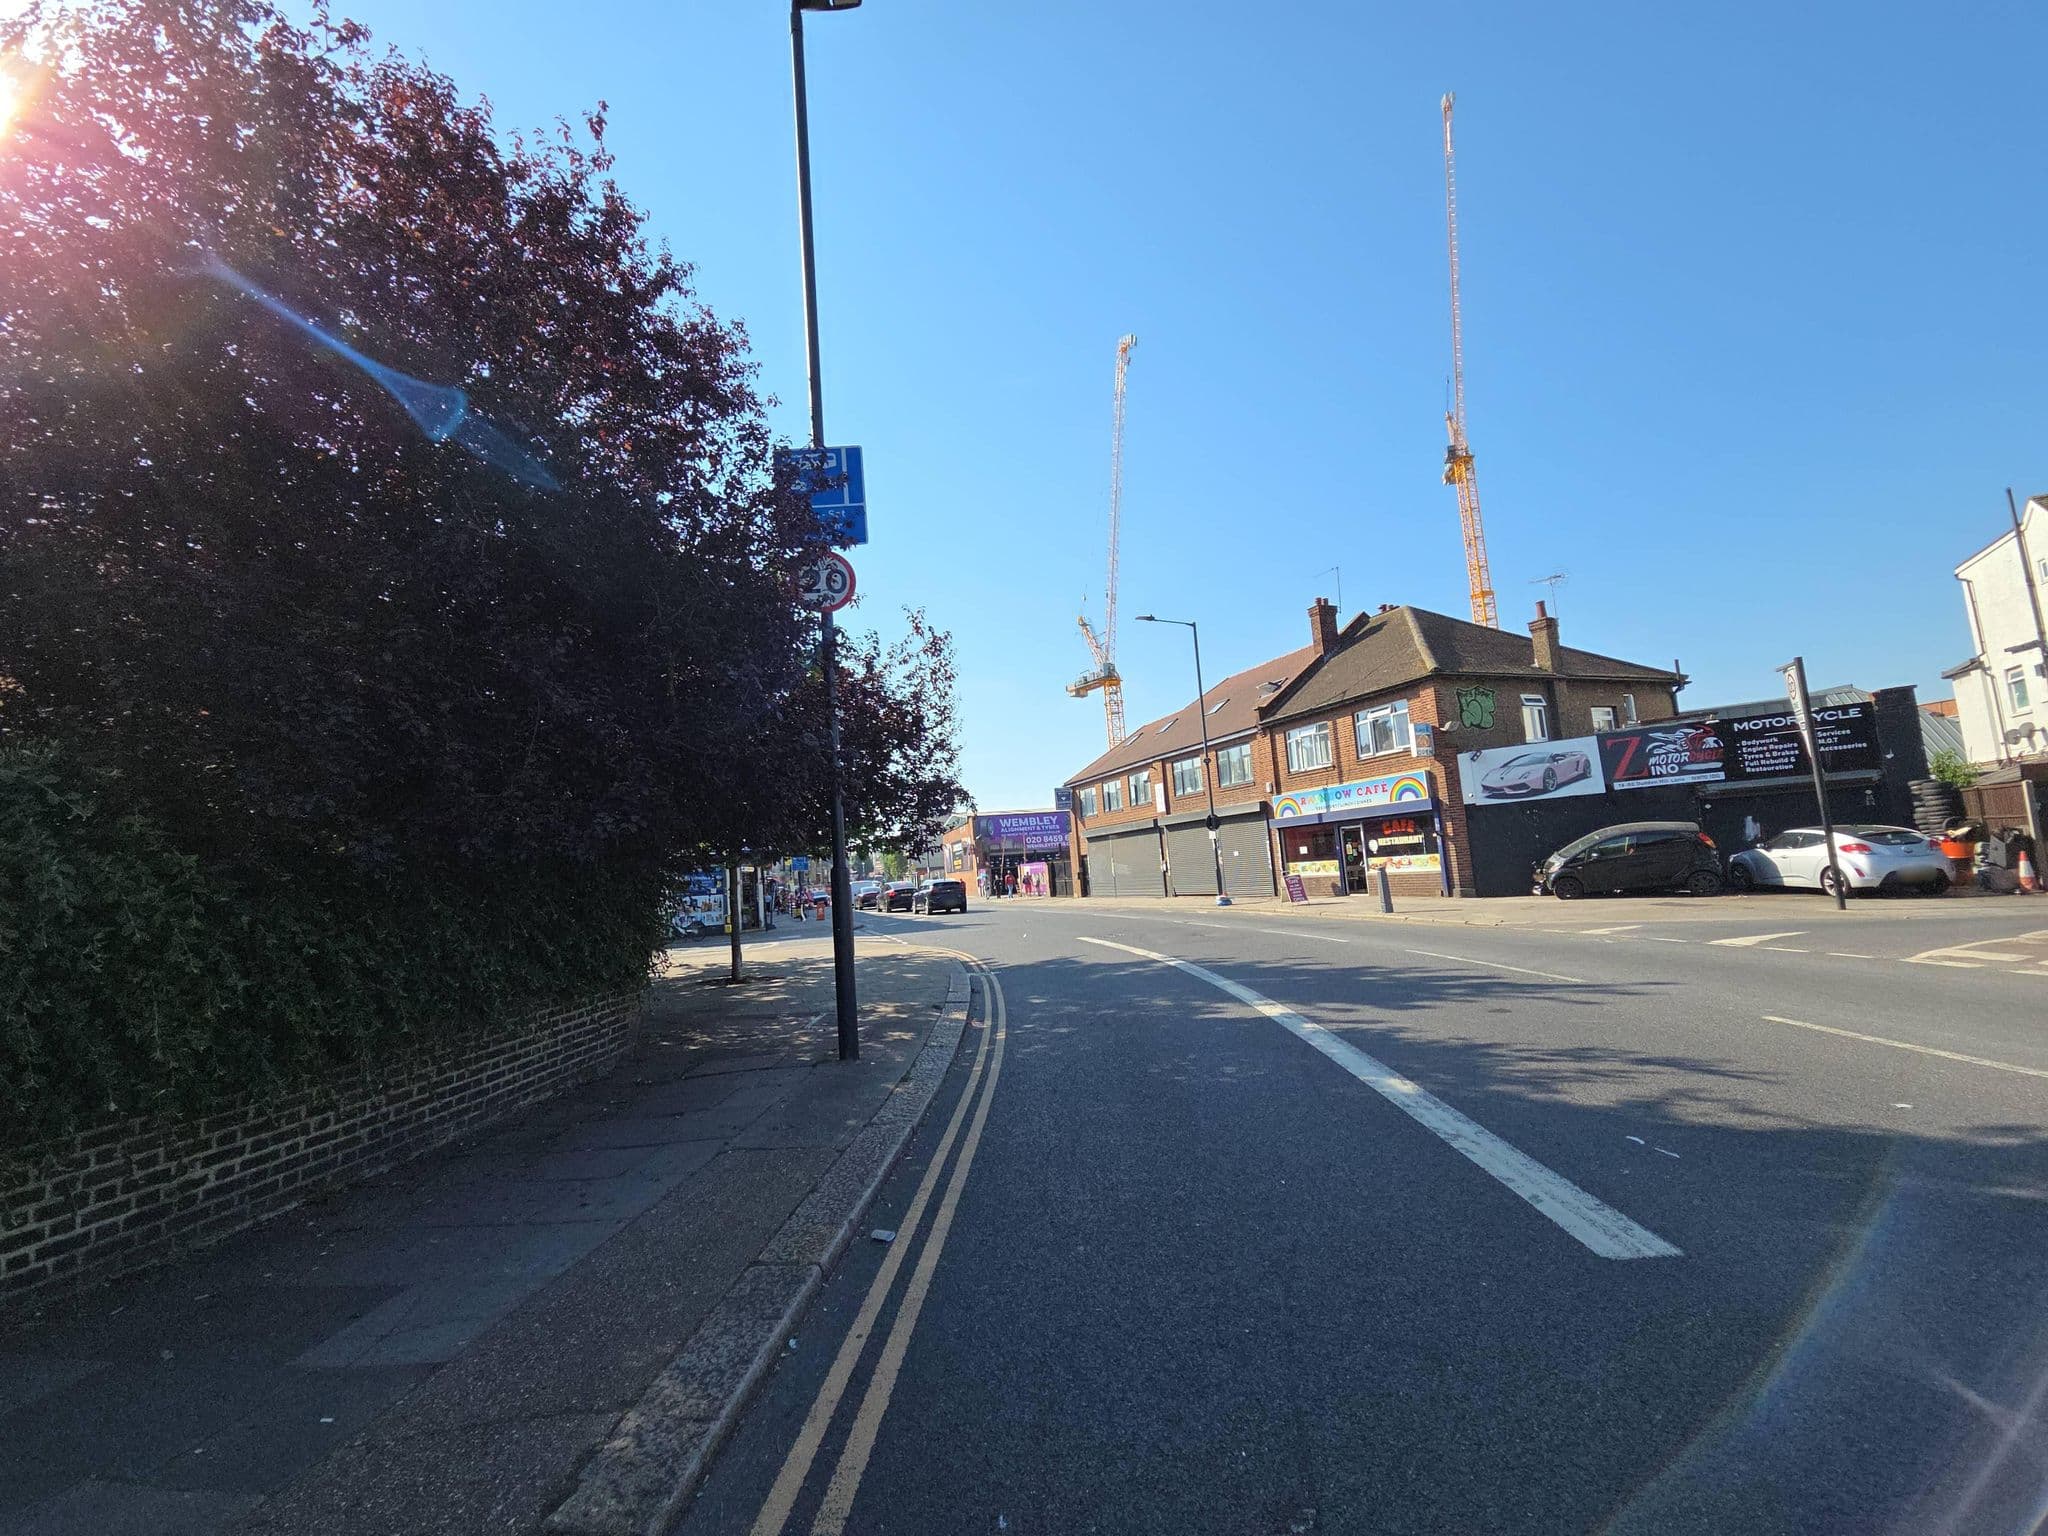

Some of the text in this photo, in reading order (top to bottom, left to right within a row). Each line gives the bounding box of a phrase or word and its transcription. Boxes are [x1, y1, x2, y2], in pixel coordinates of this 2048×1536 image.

[800, 568, 848, 594] 20
[1733, 707, 1862, 732] MOTORYCLE
[1817, 729, 1851, 738] Services
[1741, 737, 1779, 747] Bodywork
[1742, 741, 1799, 755] Engine Repairs
[1820, 742, 1868, 752] Accessories
[1606, 736, 1649, 779] Z
[1743, 752, 1766, 761] Tyres
[1772, 748, 1800, 757] Brakes
[1760, 758, 1789, 766] Rebuild
[1651, 764, 1680, 776] INO
[1300, 781, 1388, 806] RAINOW CAFÉ
[999, 815, 1058, 828] WEMBLEY
[1001, 825, 1035, 833] ALIGNMENT
[1026, 836, 1042, 844] 020
[1043, 834, 1063, 843] 8459
